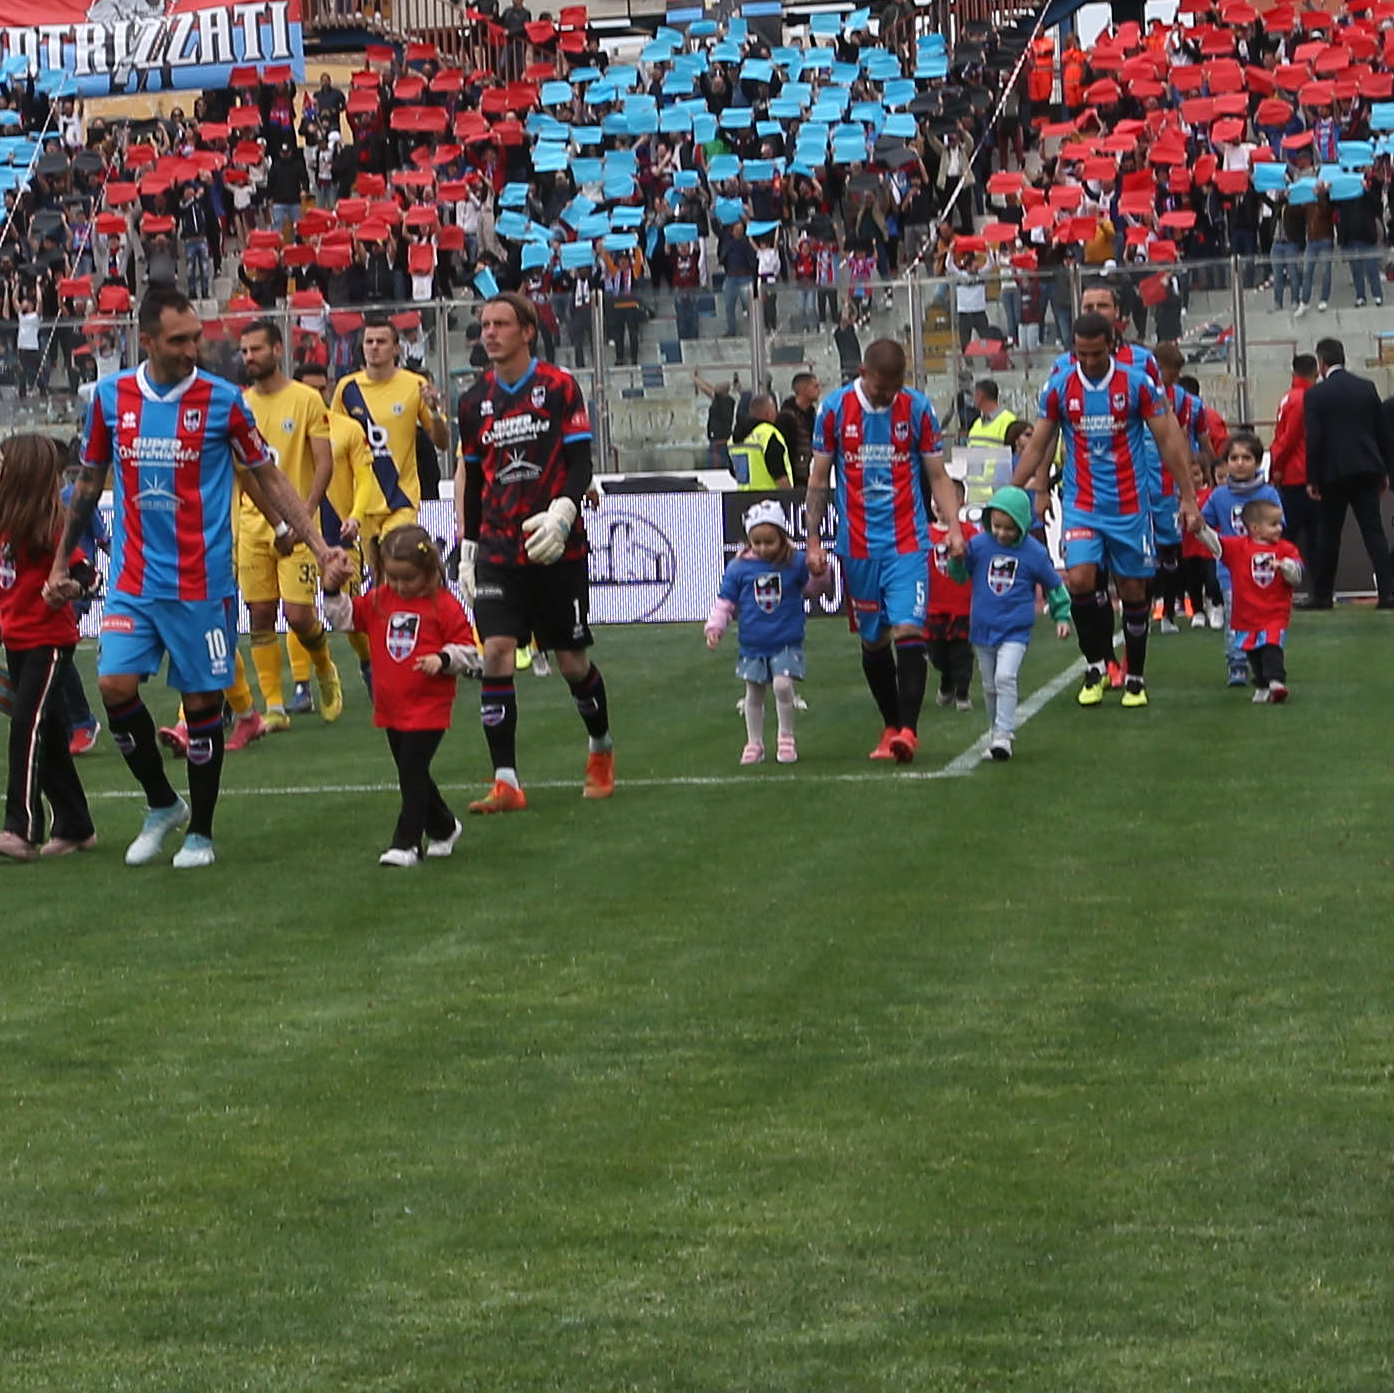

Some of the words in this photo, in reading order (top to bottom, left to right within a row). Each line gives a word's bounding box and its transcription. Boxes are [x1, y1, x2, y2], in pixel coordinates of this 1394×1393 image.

[915, 581, 926, 604] 5
[573, 598, 581, 625] 1
[205, 628, 228, 660] 10
